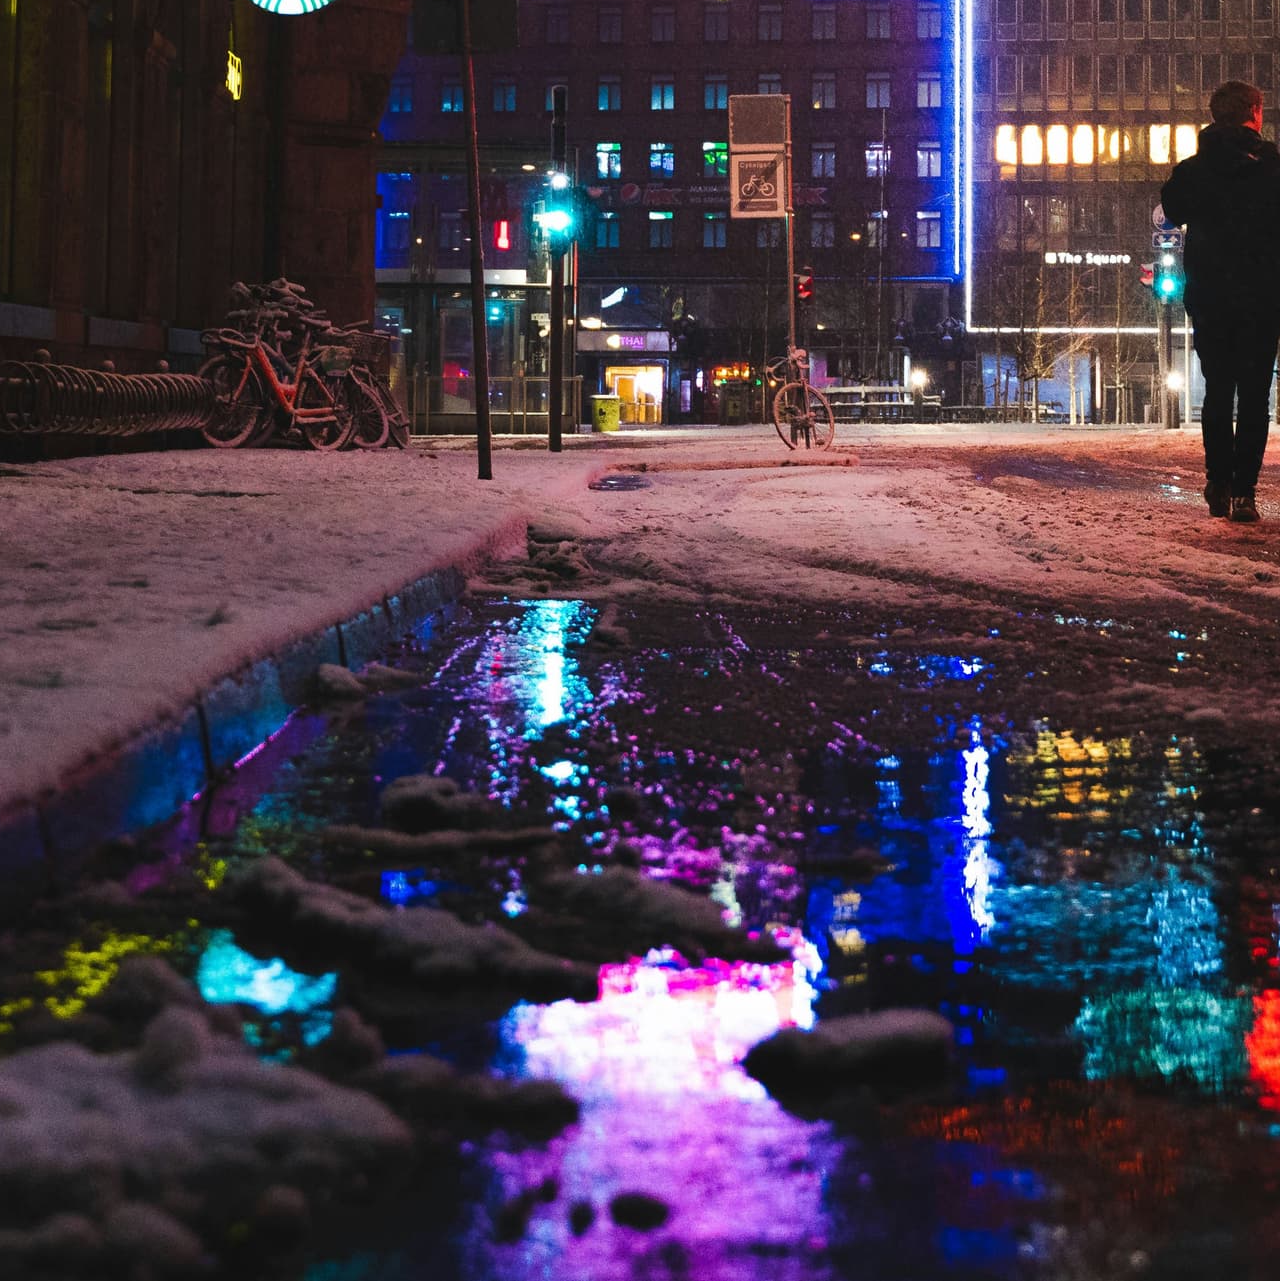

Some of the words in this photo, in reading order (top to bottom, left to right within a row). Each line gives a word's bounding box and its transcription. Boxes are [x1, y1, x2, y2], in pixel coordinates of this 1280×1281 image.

[1058, 252, 1082, 264] The
[1086, 252, 1131, 266] Square
[620, 336, 644, 346] THAI
